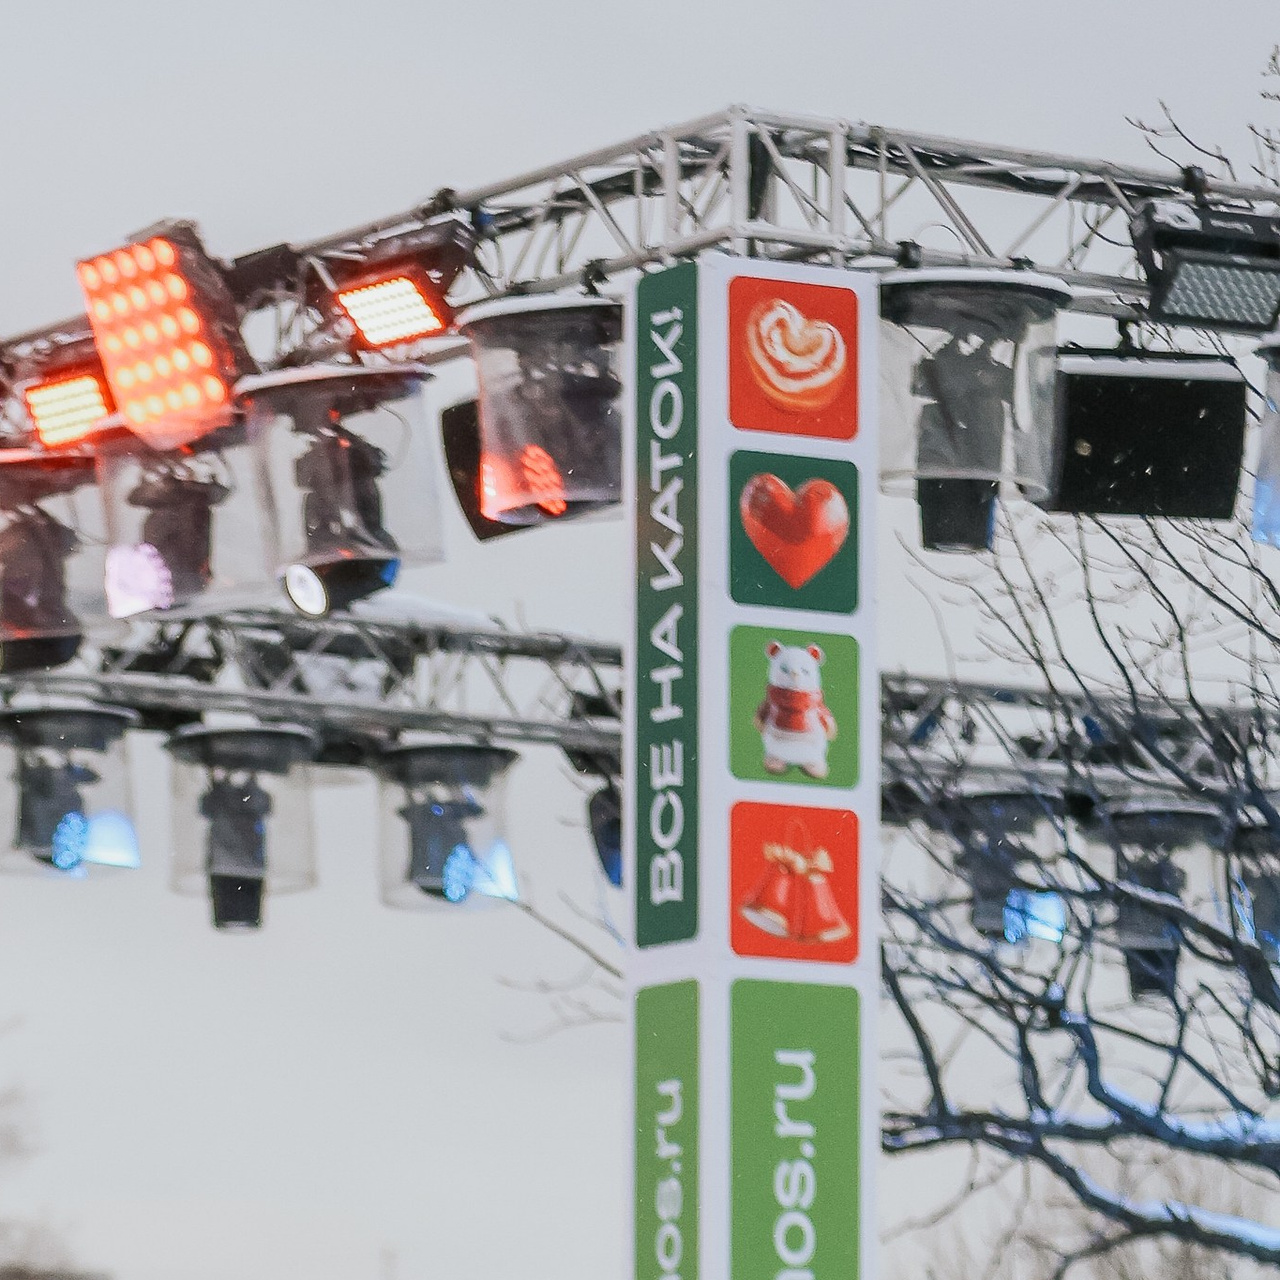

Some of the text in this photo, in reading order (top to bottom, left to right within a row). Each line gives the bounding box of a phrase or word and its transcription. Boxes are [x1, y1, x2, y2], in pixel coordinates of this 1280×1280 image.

[649, 305, 685, 904] ВСЕ НА КАТОК!
